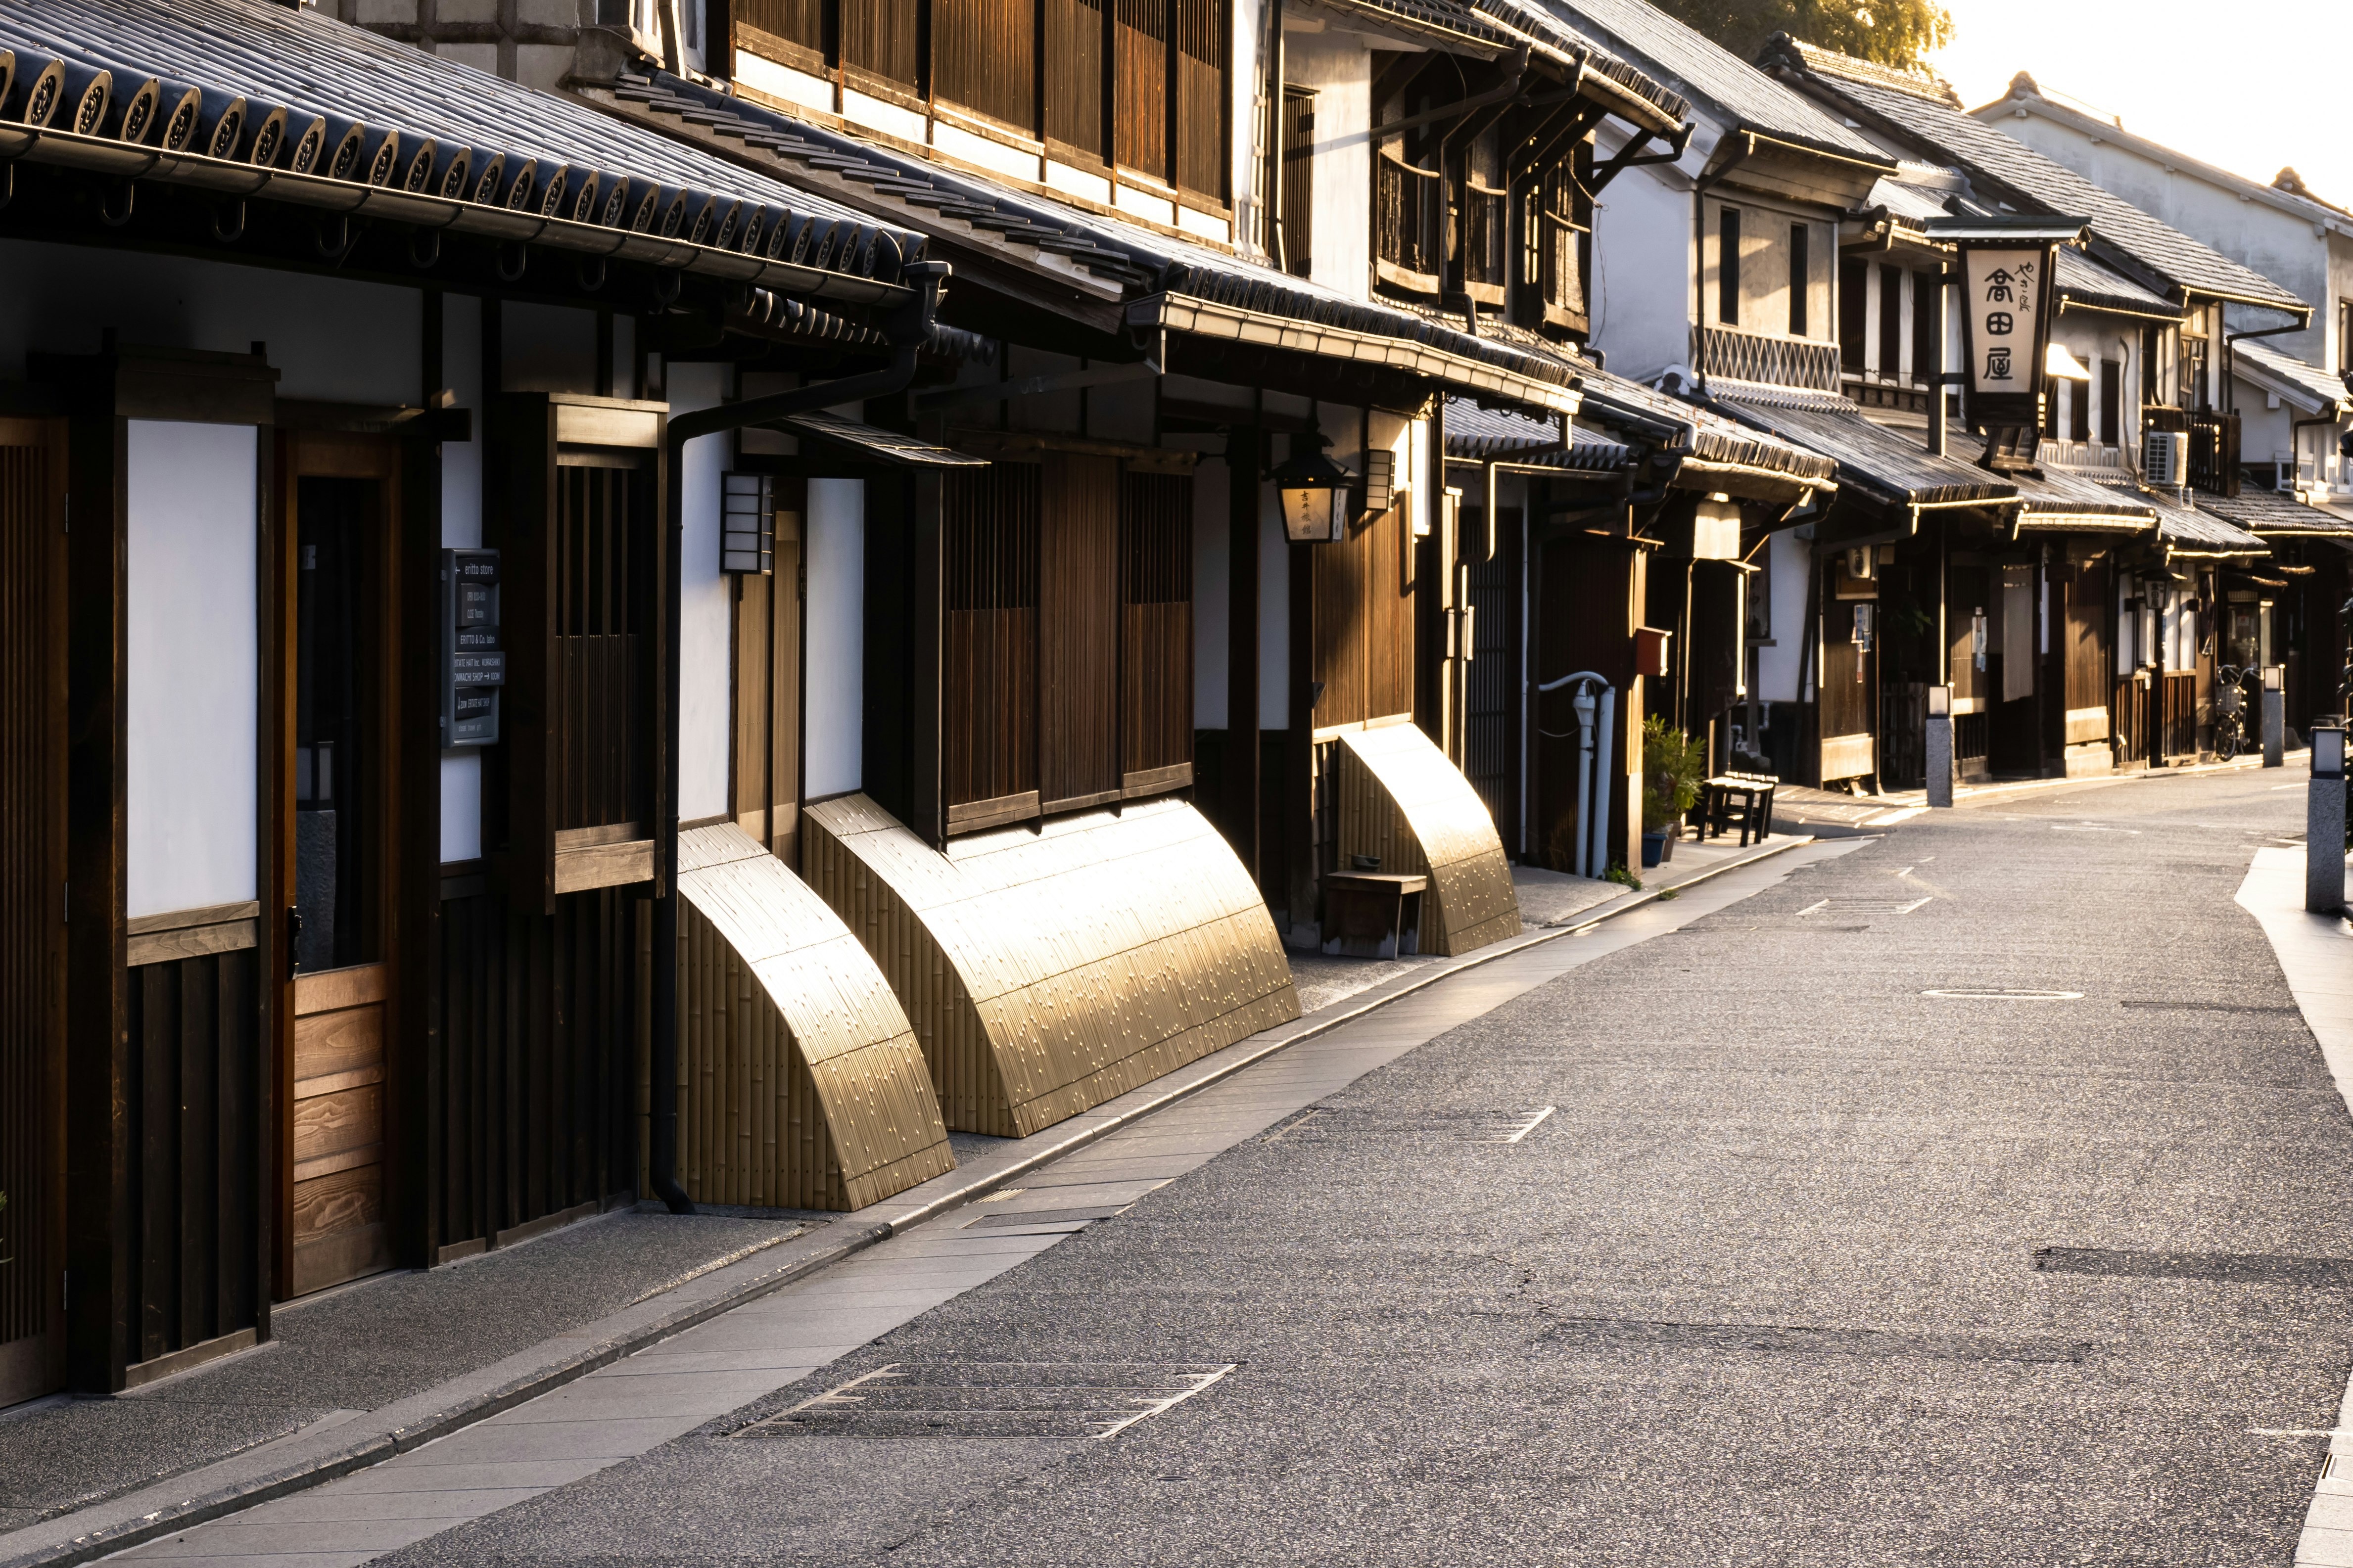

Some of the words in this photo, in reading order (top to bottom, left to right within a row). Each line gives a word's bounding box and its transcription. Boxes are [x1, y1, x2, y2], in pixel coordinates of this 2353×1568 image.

[1983, 268, 2015, 380] 高田屋
[1300, 490, 1311, 535] 吉井旅館
[465, 563, 479, 574] eritto
[480, 564, 493, 574] store
[461, 635, 474, 645] ERITTO
[475, 635, 478, 644] &
[486, 635, 495, 644] labo
[455, 672, 471, 682] ONMACHI
[472, 672, 483, 681] SHOP
